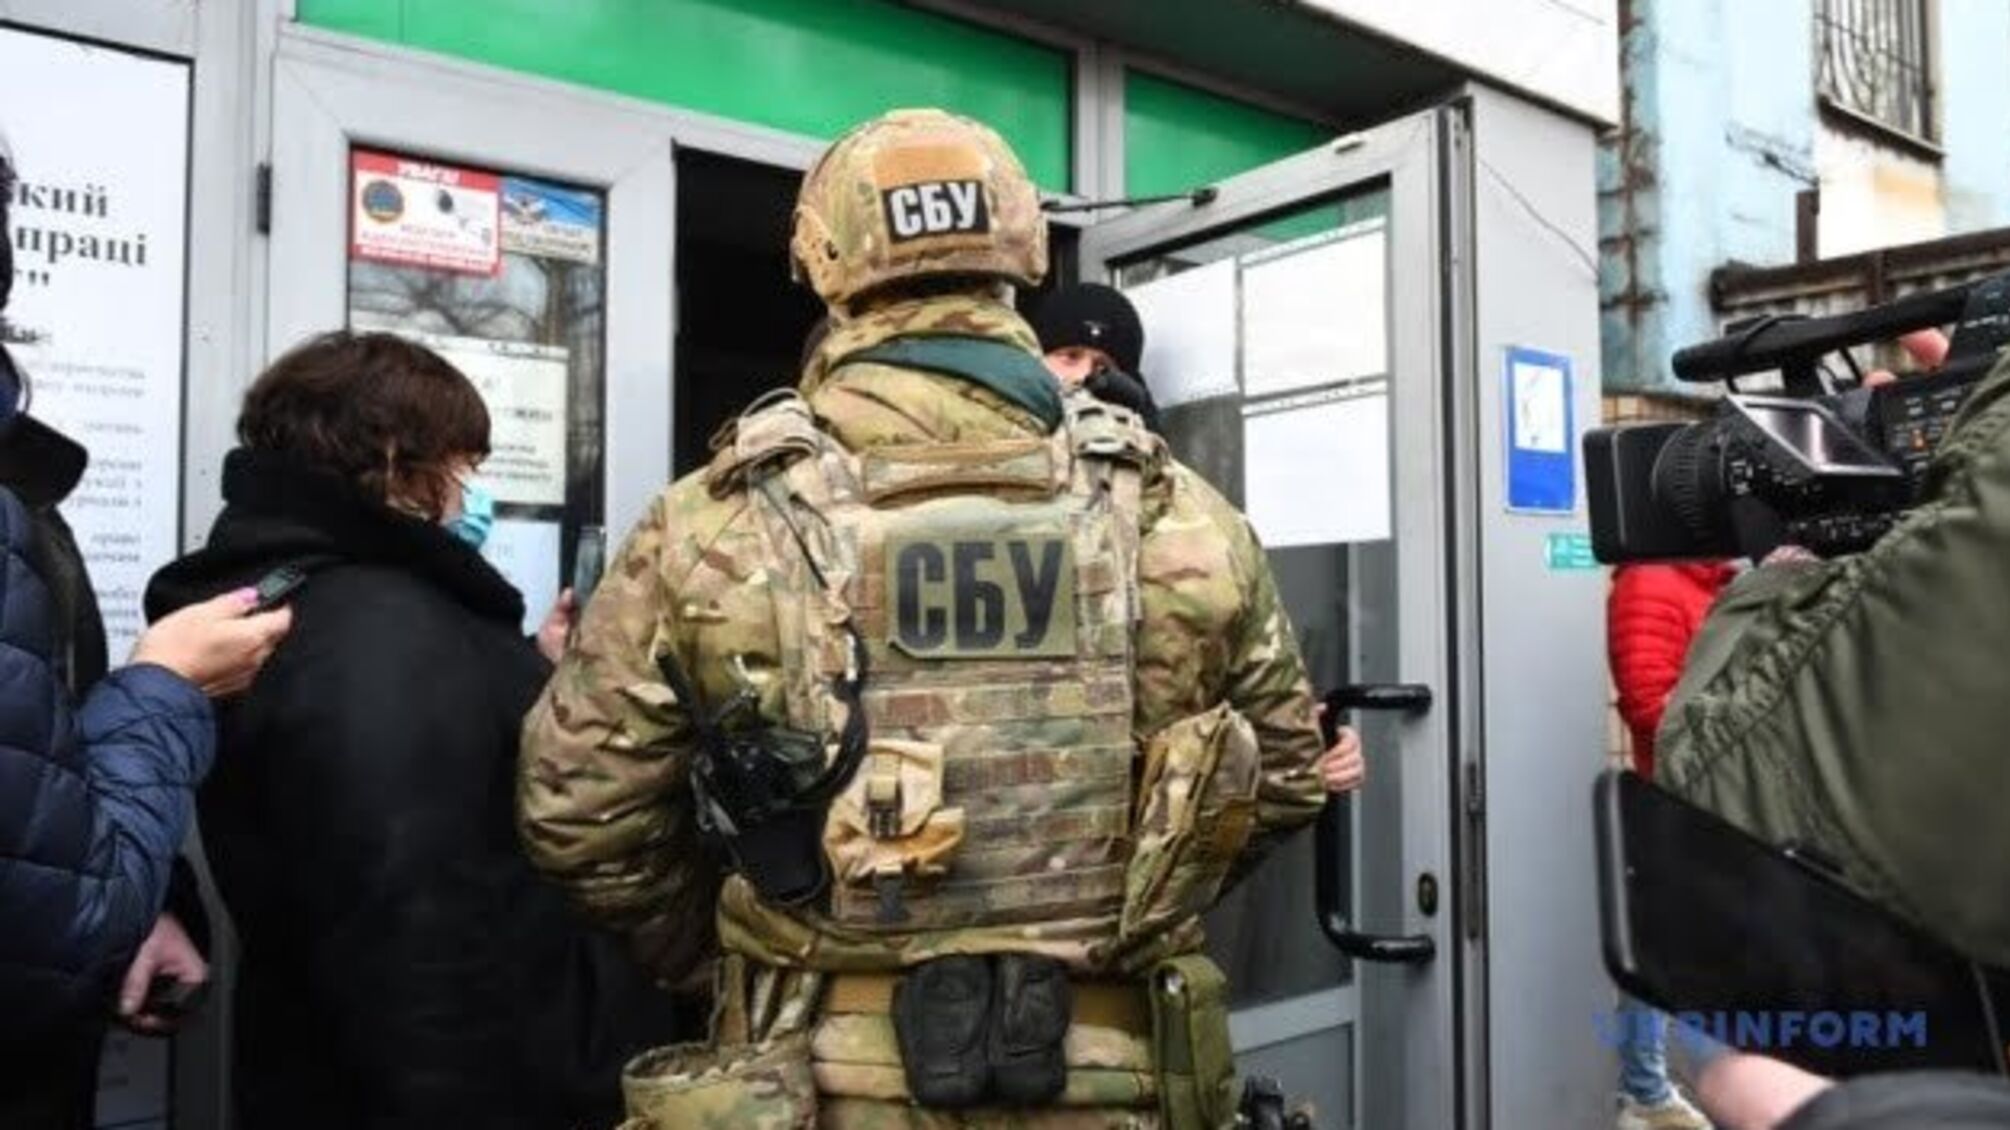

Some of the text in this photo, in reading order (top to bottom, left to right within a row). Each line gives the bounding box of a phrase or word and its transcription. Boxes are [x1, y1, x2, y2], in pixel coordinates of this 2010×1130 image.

[18, 182, 108, 218] кий
[889, 180, 979, 237] СБУ
[15, 226, 147, 267] праці
[897, 540, 1064, 651] СБУ
